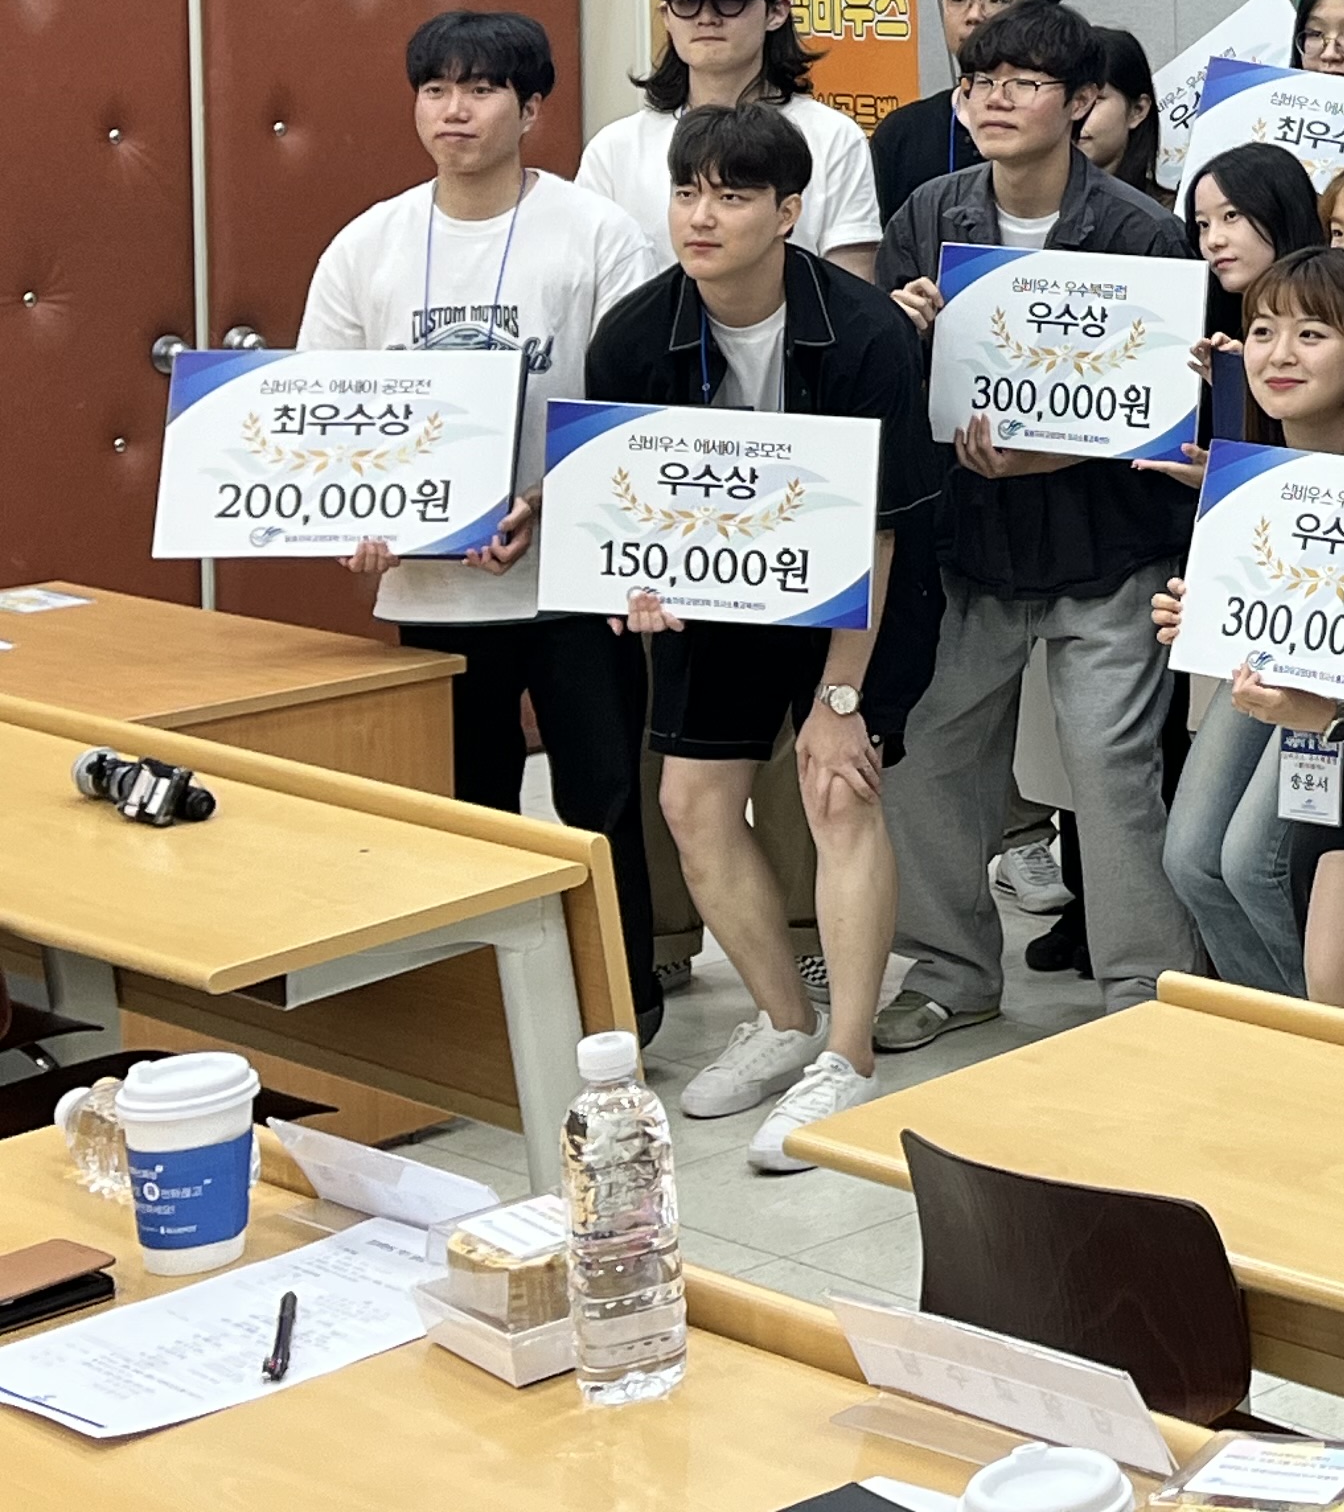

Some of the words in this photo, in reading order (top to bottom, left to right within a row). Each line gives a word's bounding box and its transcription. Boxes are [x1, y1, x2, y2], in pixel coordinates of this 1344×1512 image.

[1270, 91, 1320, 112] 심비우스
[1012, 277, 1060, 295] 심비우스
[1064, 280, 1127, 300] 우수북클럽
[1026, 302, 1108, 338] 우수상
[260, 378, 323, 395] 심비우스
[329, 378, 377, 395] 에세이
[381, 378, 432, 395] 공모전
[971, 375, 1151, 429] 300,000원
[270, 402, 413, 436] 최우수상
[627, 434, 690, 452] 심비우스
[693, 438, 740, 457] 에세이
[744, 441, 792, 460] 공모전
[657, 462, 759, 500] 우수상
[1280, 481, 1335, 507] 심비우스
[214, 478, 452, 524] 200,000원
[600, 539, 809, 594] 150,000원
